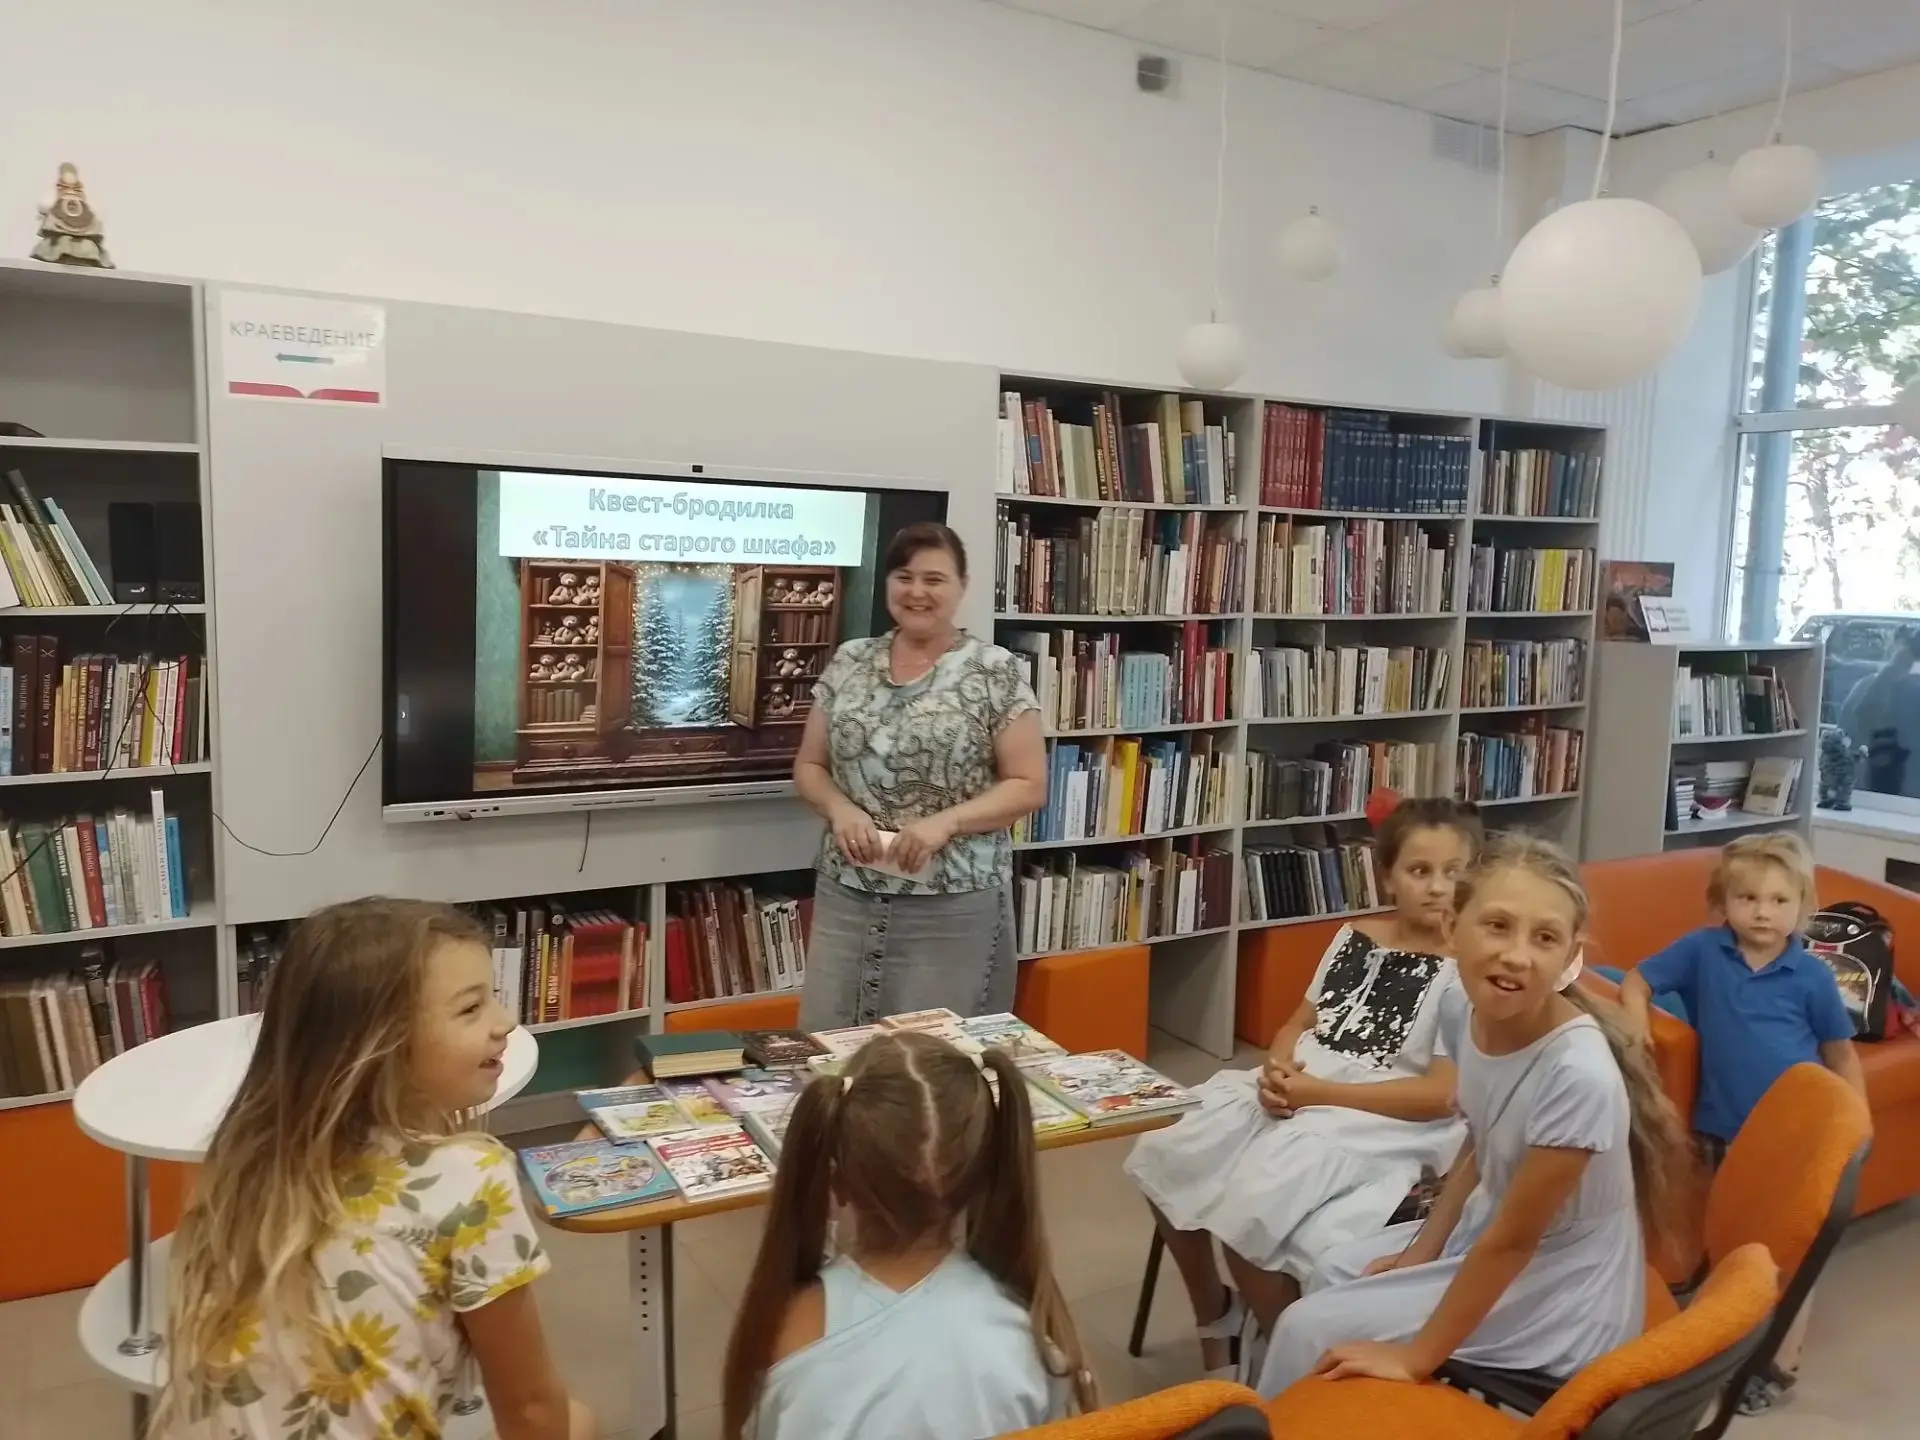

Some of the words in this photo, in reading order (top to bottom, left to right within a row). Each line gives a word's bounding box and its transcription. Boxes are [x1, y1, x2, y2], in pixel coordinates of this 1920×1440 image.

[229, 321, 376, 348] КРАЕВЕДЕНИЕ
[588, 488, 794, 521] Квест-бродилка
[532, 525, 631, 550] «Тайна
[639, 533, 736, 556] старого
[743, 534, 836, 559] шкафа»
